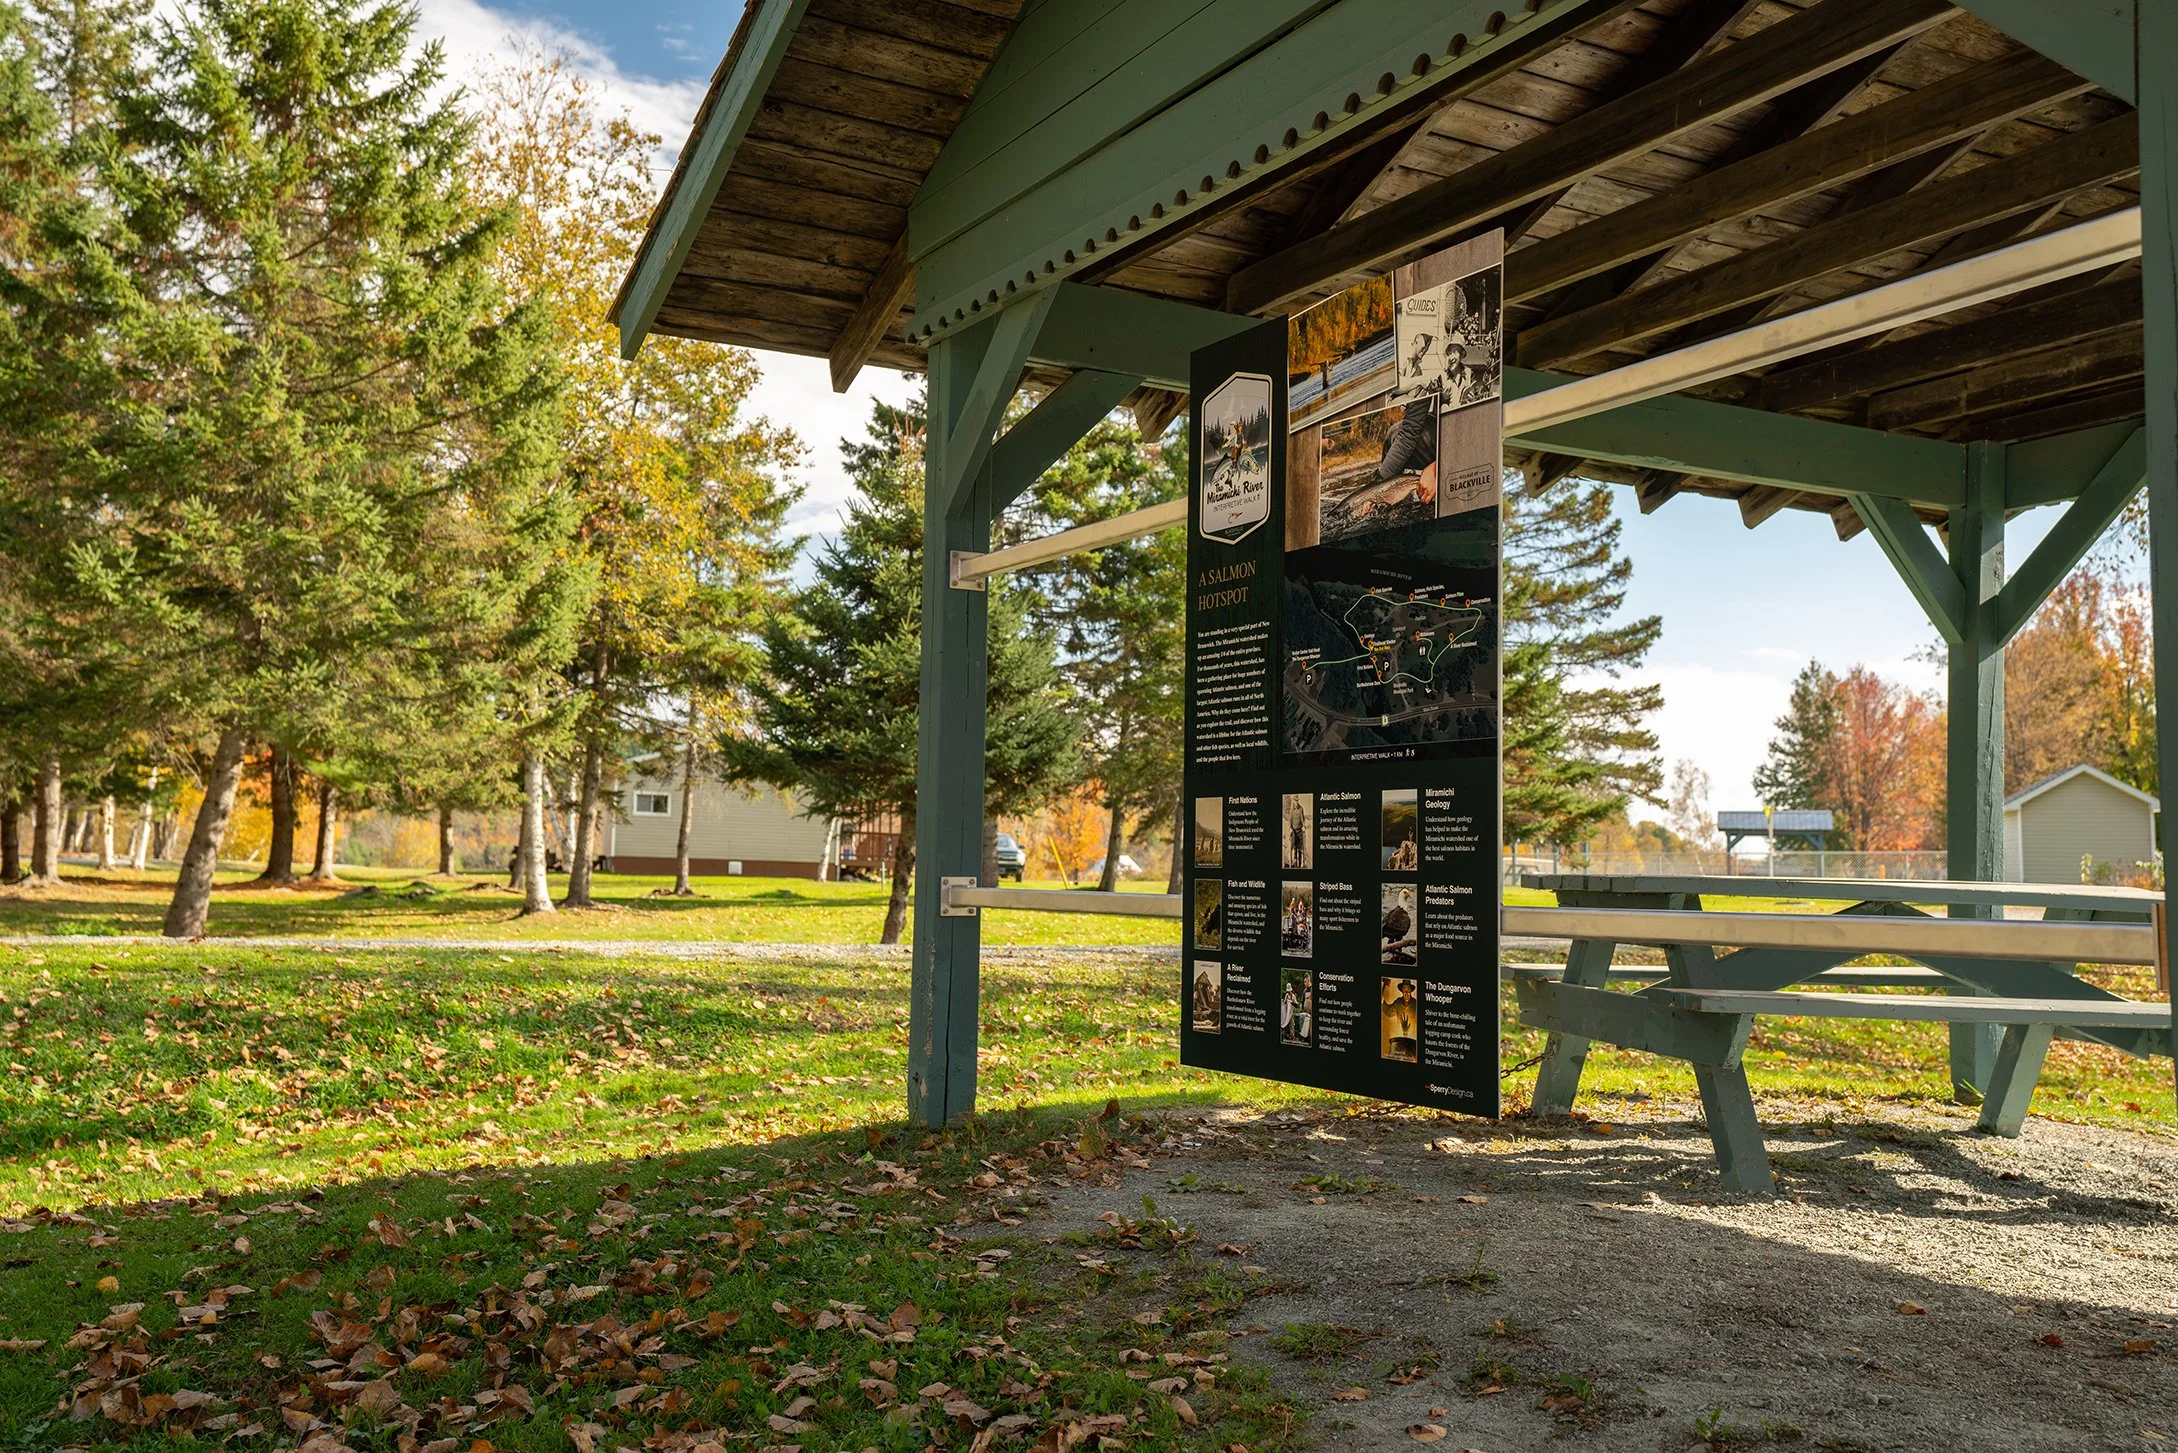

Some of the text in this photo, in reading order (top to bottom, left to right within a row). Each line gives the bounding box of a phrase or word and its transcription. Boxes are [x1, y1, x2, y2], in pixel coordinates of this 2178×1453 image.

[1407, 298, 1436, 313] GUIDES
[1215, 484, 1224, 492] The
[1450, 474, 1490, 492] BLACKVILLE
[1207, 481, 1265, 504] Miramichi River
[1214, 498, 1243, 512] INTERPRETIVE
[1198, 560, 1256, 587] A SALMON
[1198, 586, 1249, 610] HOTSPOT
[1340, 792, 1362, 800] Salmon
[1425, 788, 1454, 796] Miramichi
[1425, 800, 1450, 810] Geology
[1320, 882, 1353, 892] Striped Bass
[1425, 885, 1473, 894] Atlantic Salmon
[1425, 896, 1454, 905] Predators
[1232, 964, 1244, 972] River
[1226, 973, 1251, 983] Reclaimed
[1319, 972, 1354, 982] Conservation
[1319, 982, 1336, 992] Efforts
[1425, 981, 1472, 994] The Dungarvon
[1425, 993, 1453, 1004] Whooper
[1450, 1012, 1476, 1022] bone-chilling
[1425, 1029, 1440, 1038] logging
[1425, 1048, 1446, 1057] Dungarvon
[1430, 1084, 1474, 1098] SperryDesign.ca
